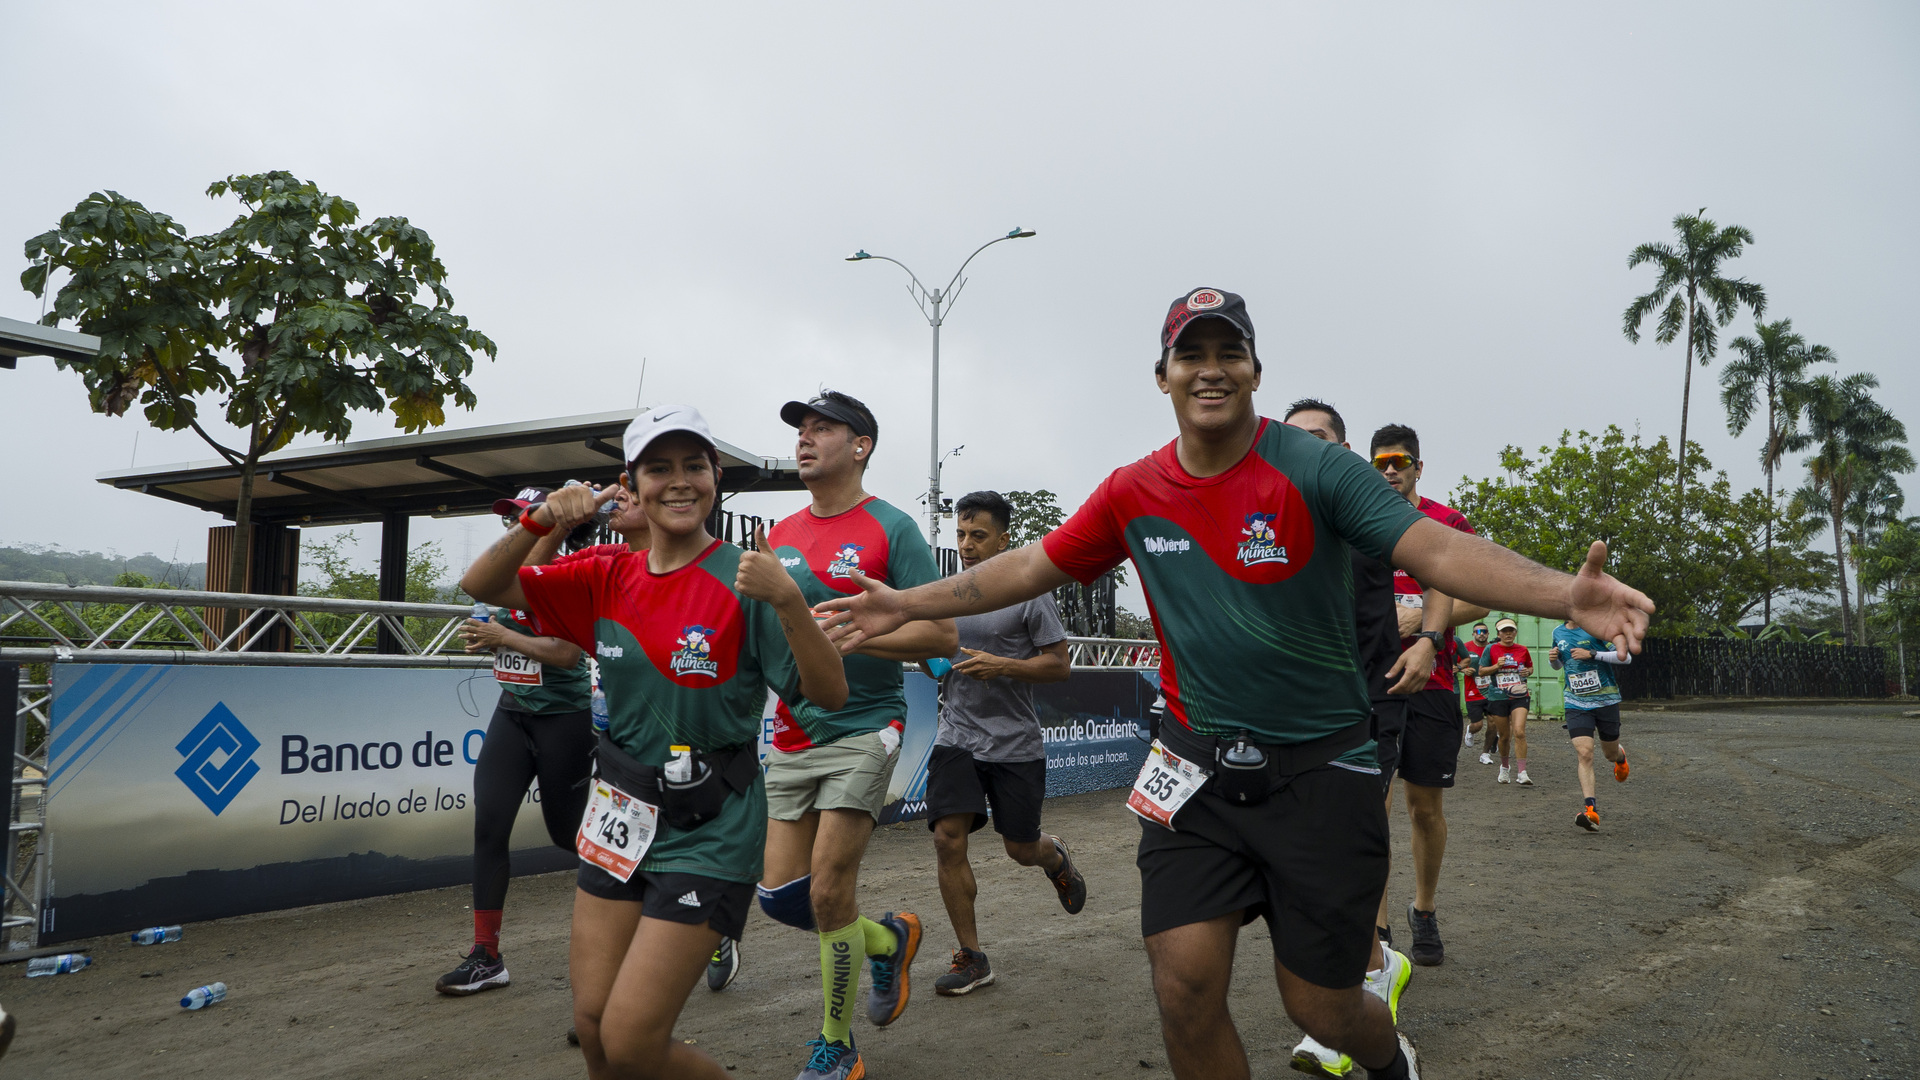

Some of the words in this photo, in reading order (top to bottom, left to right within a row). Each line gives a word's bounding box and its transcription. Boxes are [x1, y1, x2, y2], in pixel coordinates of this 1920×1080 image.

[514, 488, 541, 501] UN
[1236, 545, 1287, 564] Muñeca
[1250, 541, 1260, 549] La
[498, 653, 530, 671] 1067
[670, 655, 718, 673] Muñeca
[682, 650, 693, 660] La
[1041, 726, 1067, 743] anco
[1070, 720, 1084, 741] de
[1086, 719, 1138, 740] Occidente
[281, 734, 402, 774] Banco
[411, 731, 454, 767] de
[1046, 754, 1065, 769] lado
[1066, 753, 1076, 767] de
[1077, 752, 1089, 766] los
[1090, 755, 1104, 767] que
[1105, 750, 1129, 763] hacen.
[1143, 766, 1181, 801] 255
[279, 795, 326, 825] Del
[333, 792, 391, 820] lado
[397, 789, 427, 814] de
[434, 787, 467, 811] los
[901, 801, 928, 814] AVA
[596, 812, 629, 849] 143
[678, 897, 701, 907] adidas
[830, 942, 851, 1021] RUNNING
